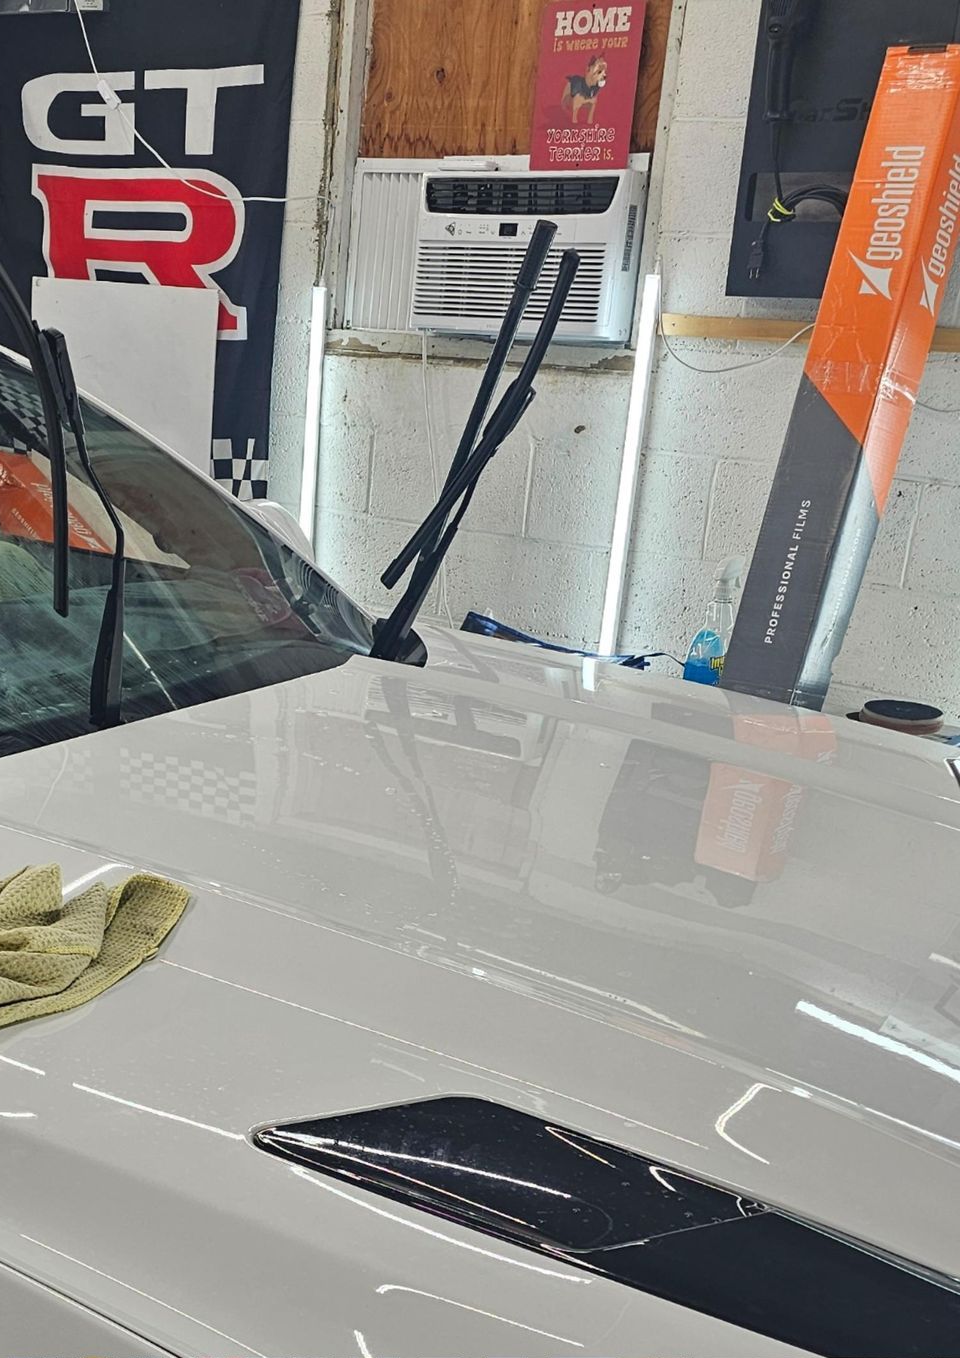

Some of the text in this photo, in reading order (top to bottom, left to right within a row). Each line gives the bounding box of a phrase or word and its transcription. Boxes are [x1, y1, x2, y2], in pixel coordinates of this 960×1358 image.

[553, 37, 564, 52] is
[554, 6, 632, 36] HOME
[21, 64, 264, 155] GT
[31, 163, 248, 341] R
[866, 145, 925, 261] geoshield
[764, 500, 811, 644] PROFESSIONAL FILMS
